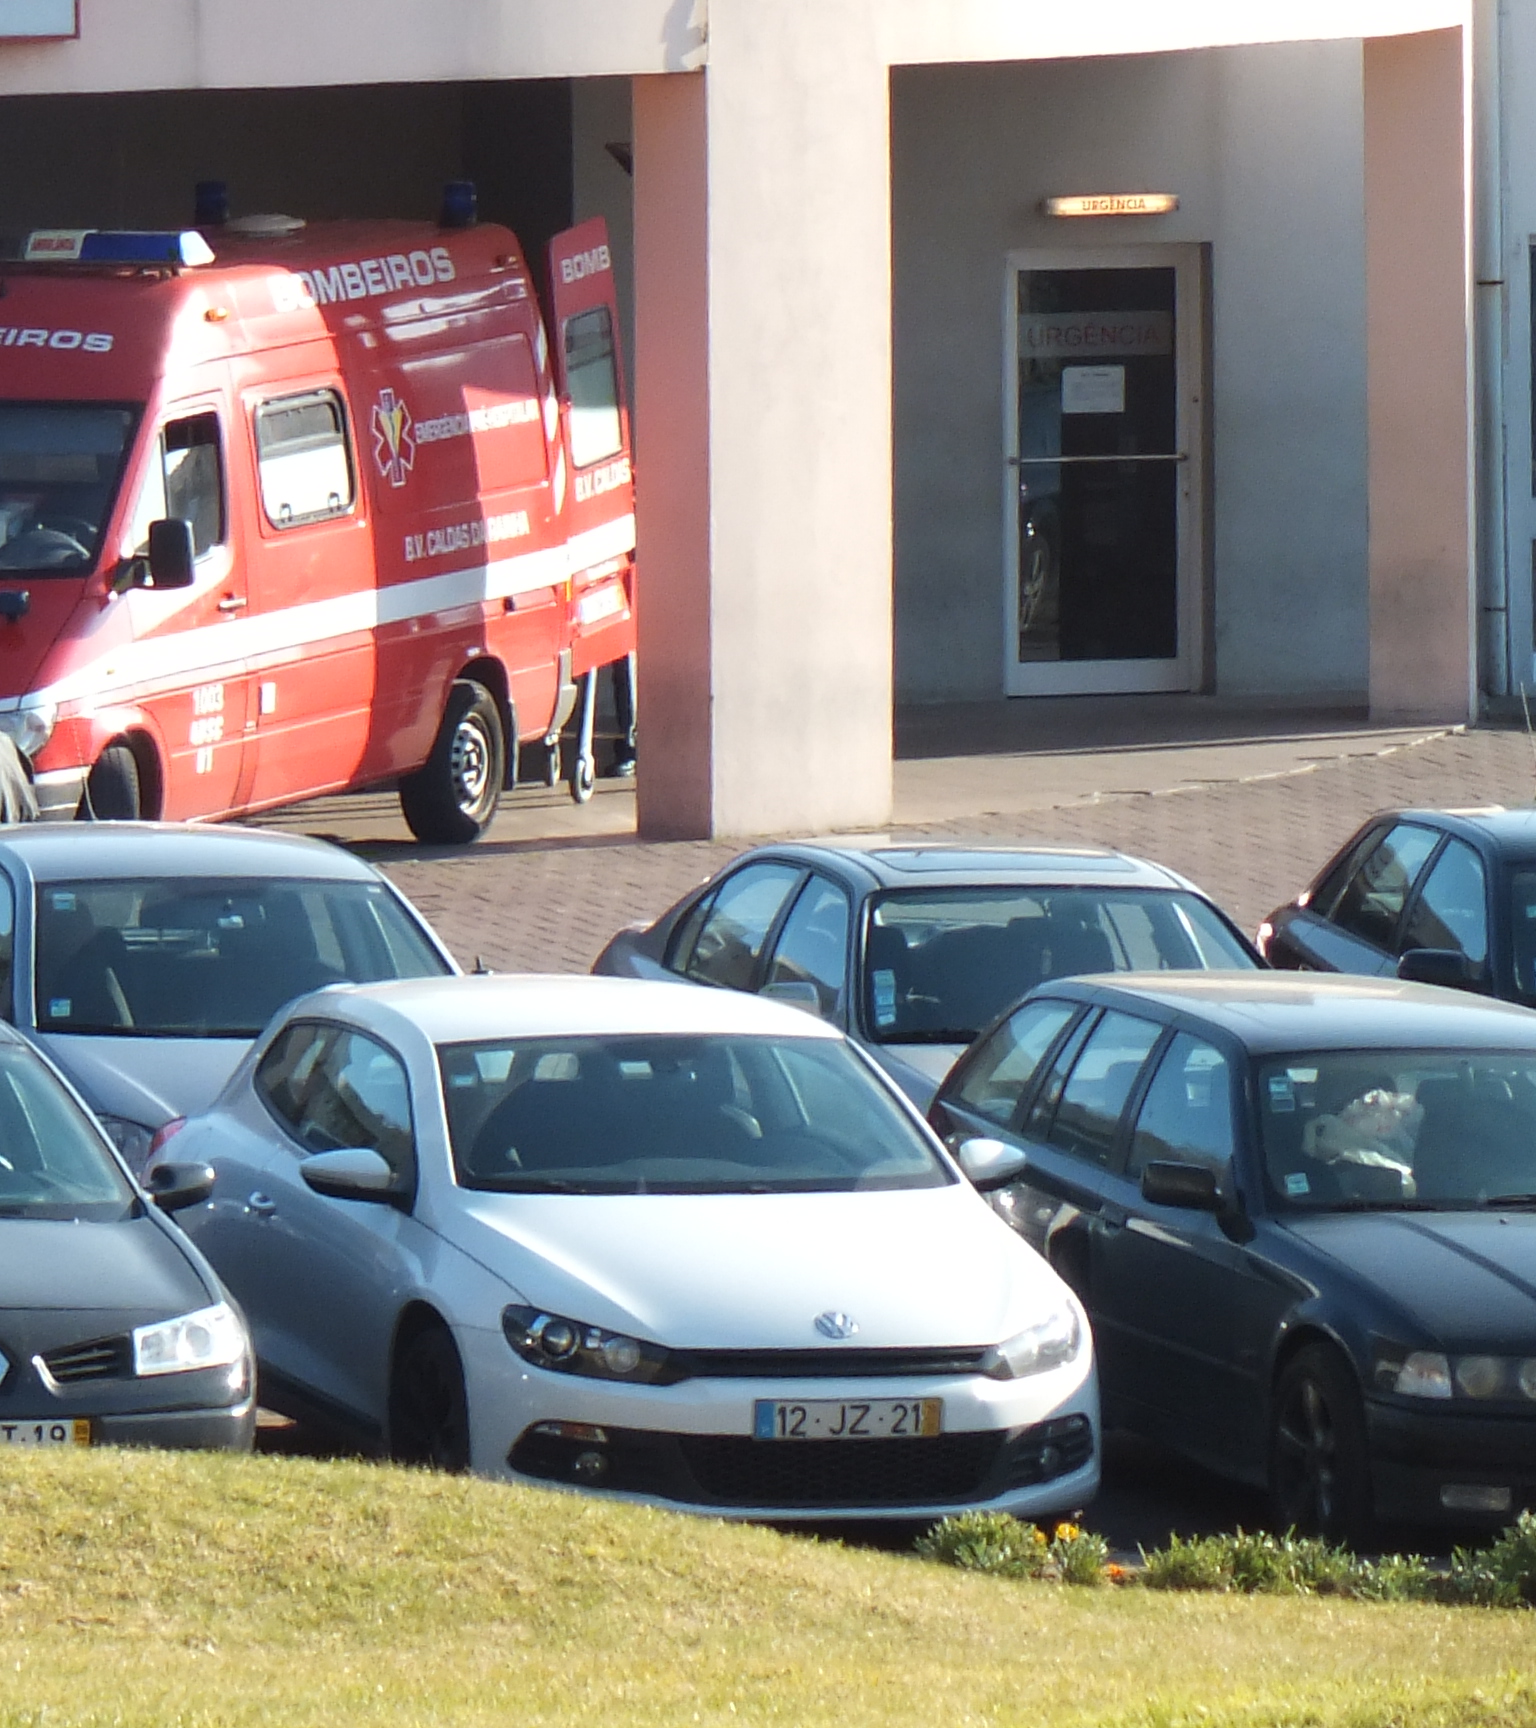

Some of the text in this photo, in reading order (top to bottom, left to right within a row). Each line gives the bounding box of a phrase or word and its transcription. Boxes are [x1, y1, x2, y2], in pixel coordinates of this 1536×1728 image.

[1082, 196, 1147, 212] URGÊNCIA
[265, 246, 457, 314] BOMBEIROS
[561, 244, 611, 285] BOMB
[1027, 322, 1161, 349] URGÊNCIA
